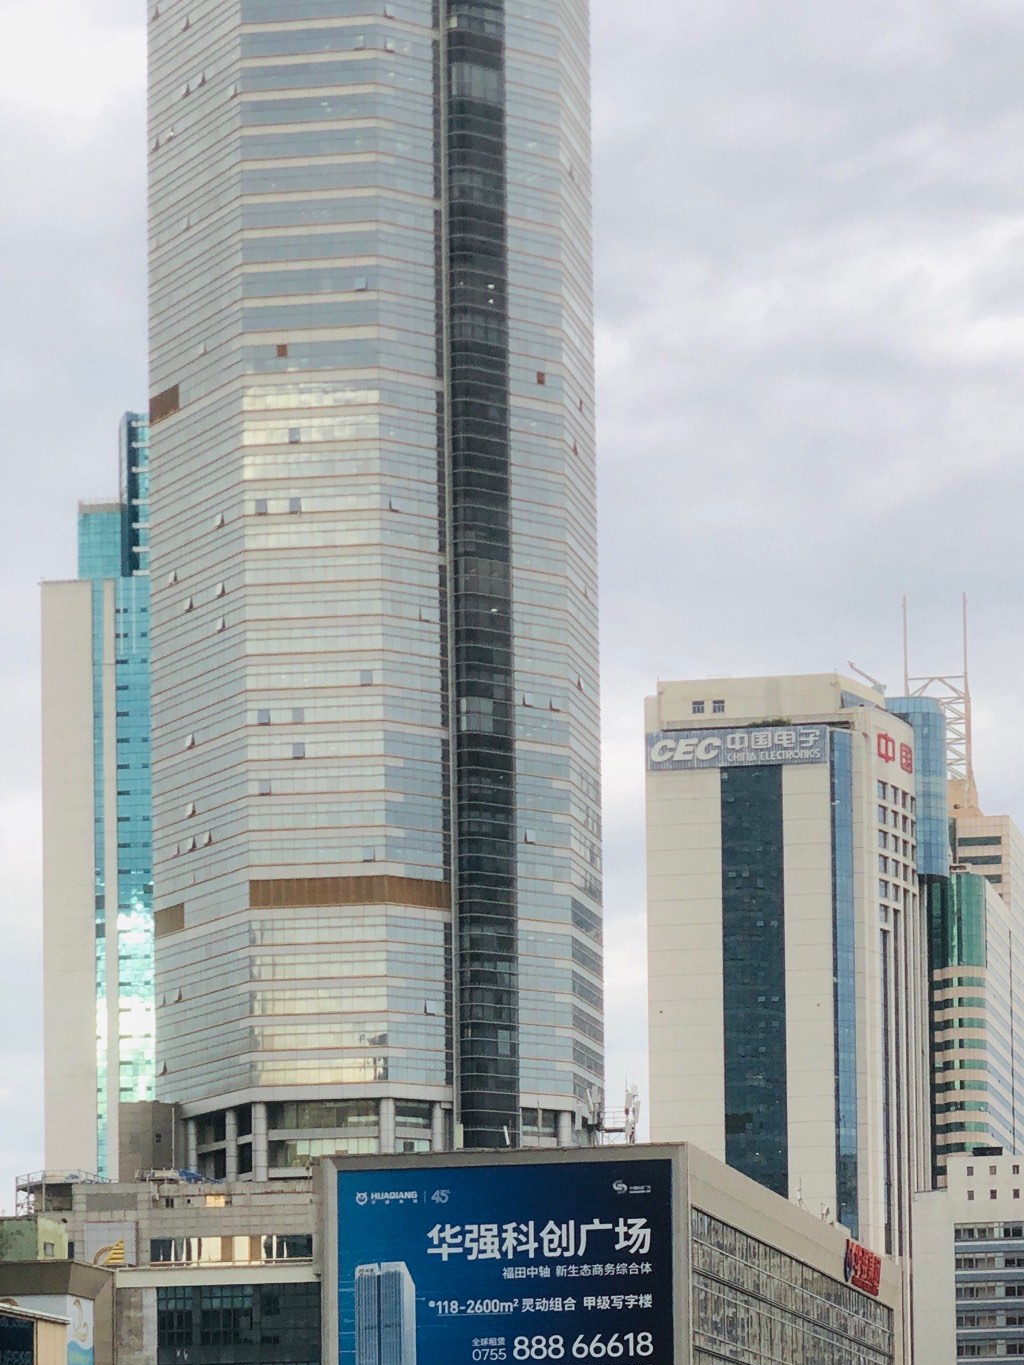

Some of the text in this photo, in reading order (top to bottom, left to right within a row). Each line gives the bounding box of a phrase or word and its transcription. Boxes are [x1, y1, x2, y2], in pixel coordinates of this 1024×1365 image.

[650, 737, 722, 763] CEC
[726, 730, 821, 751] 中国电子
[727, 749, 821, 762] CHINA ELECTRONICS
[370, 1191, 418, 1200] HUAQIANG
[427, 1217, 652, 1261] 华强科创广场
[502, 1262, 653, 1280] 福田中轴 新生态商务综合体
[521, 1297, 577, 1313] 灵动组合
[583, 1294, 653, 1310] 甲级写字楼
[472, 1337, 506, 1347] 全球租赁
[472, 1332, 654, 1361] 0755 888 66618
